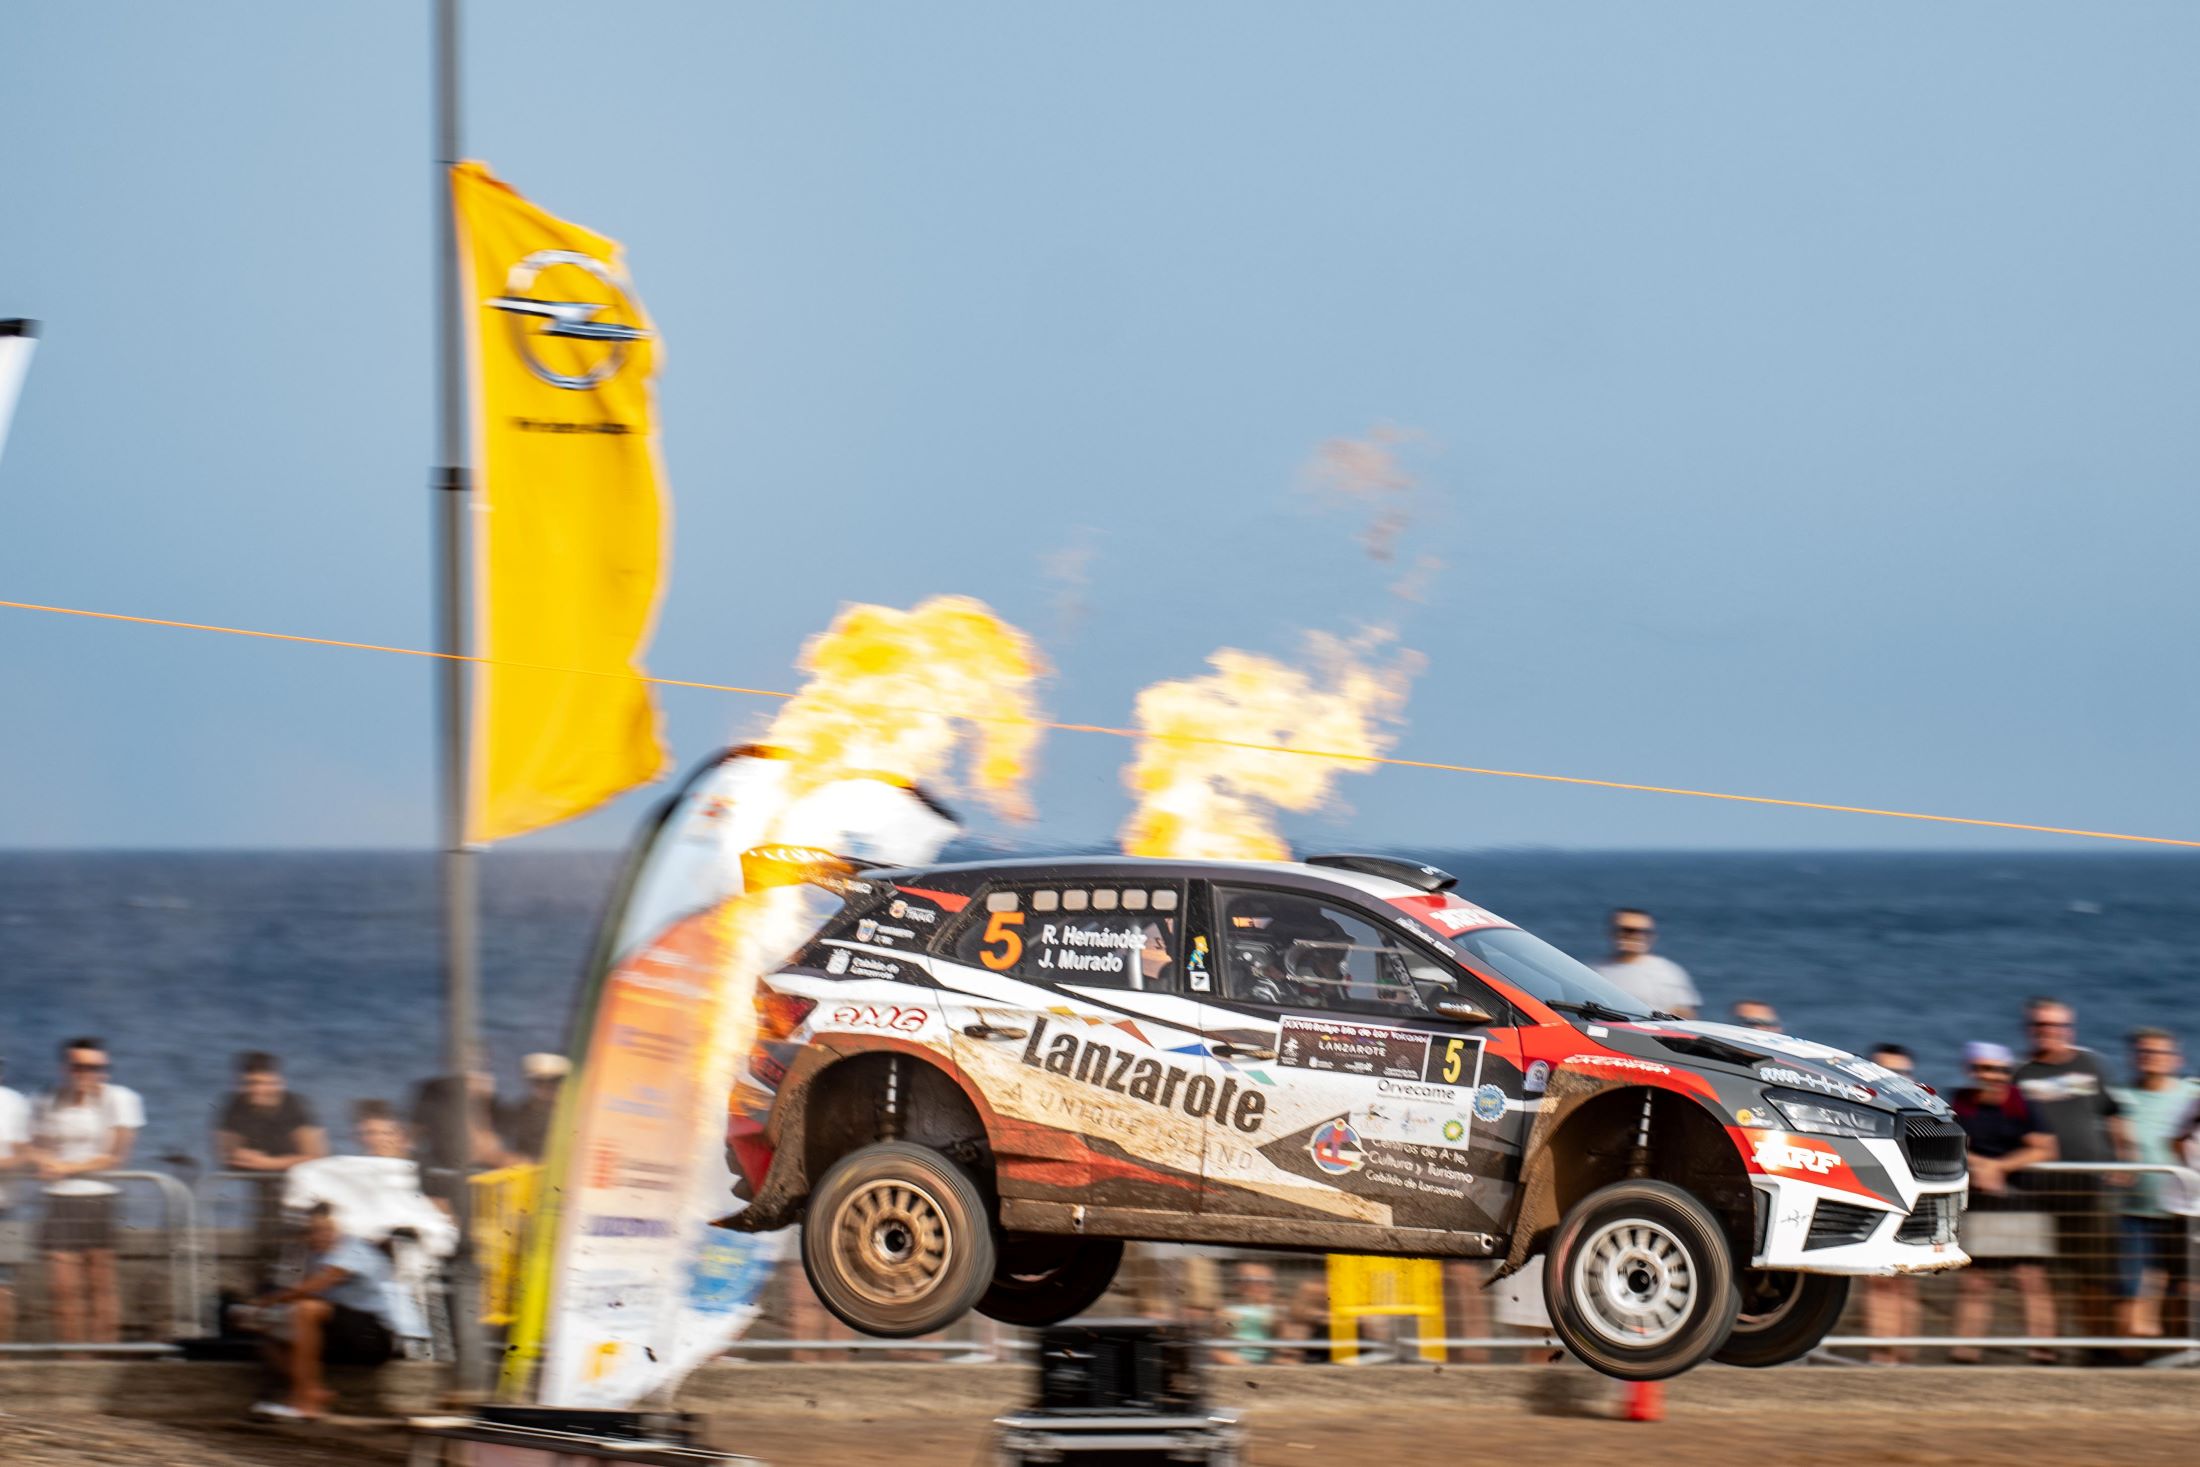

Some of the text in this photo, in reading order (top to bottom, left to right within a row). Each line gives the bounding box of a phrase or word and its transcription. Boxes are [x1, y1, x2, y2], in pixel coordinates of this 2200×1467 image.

[979, 911, 1025, 971] 5
[1041, 924, 1060, 945] R.
[1038, 947, 1123, 973] J. Murado
[1318, 1041, 1387, 1057] LANZAROTE
[1442, 1039, 1465, 1083] 5
[1022, 1015, 1266, 1133] Lanzarote
[1377, 1079, 1456, 1100] Orvecame
[1420, 1145, 1438, 1159] de
[1368, 1150, 1474, 1184] Cultura y Turismo
[1365, 1169, 1404, 1187] Cabildo
[1403, 1177, 1418, 1190] de
